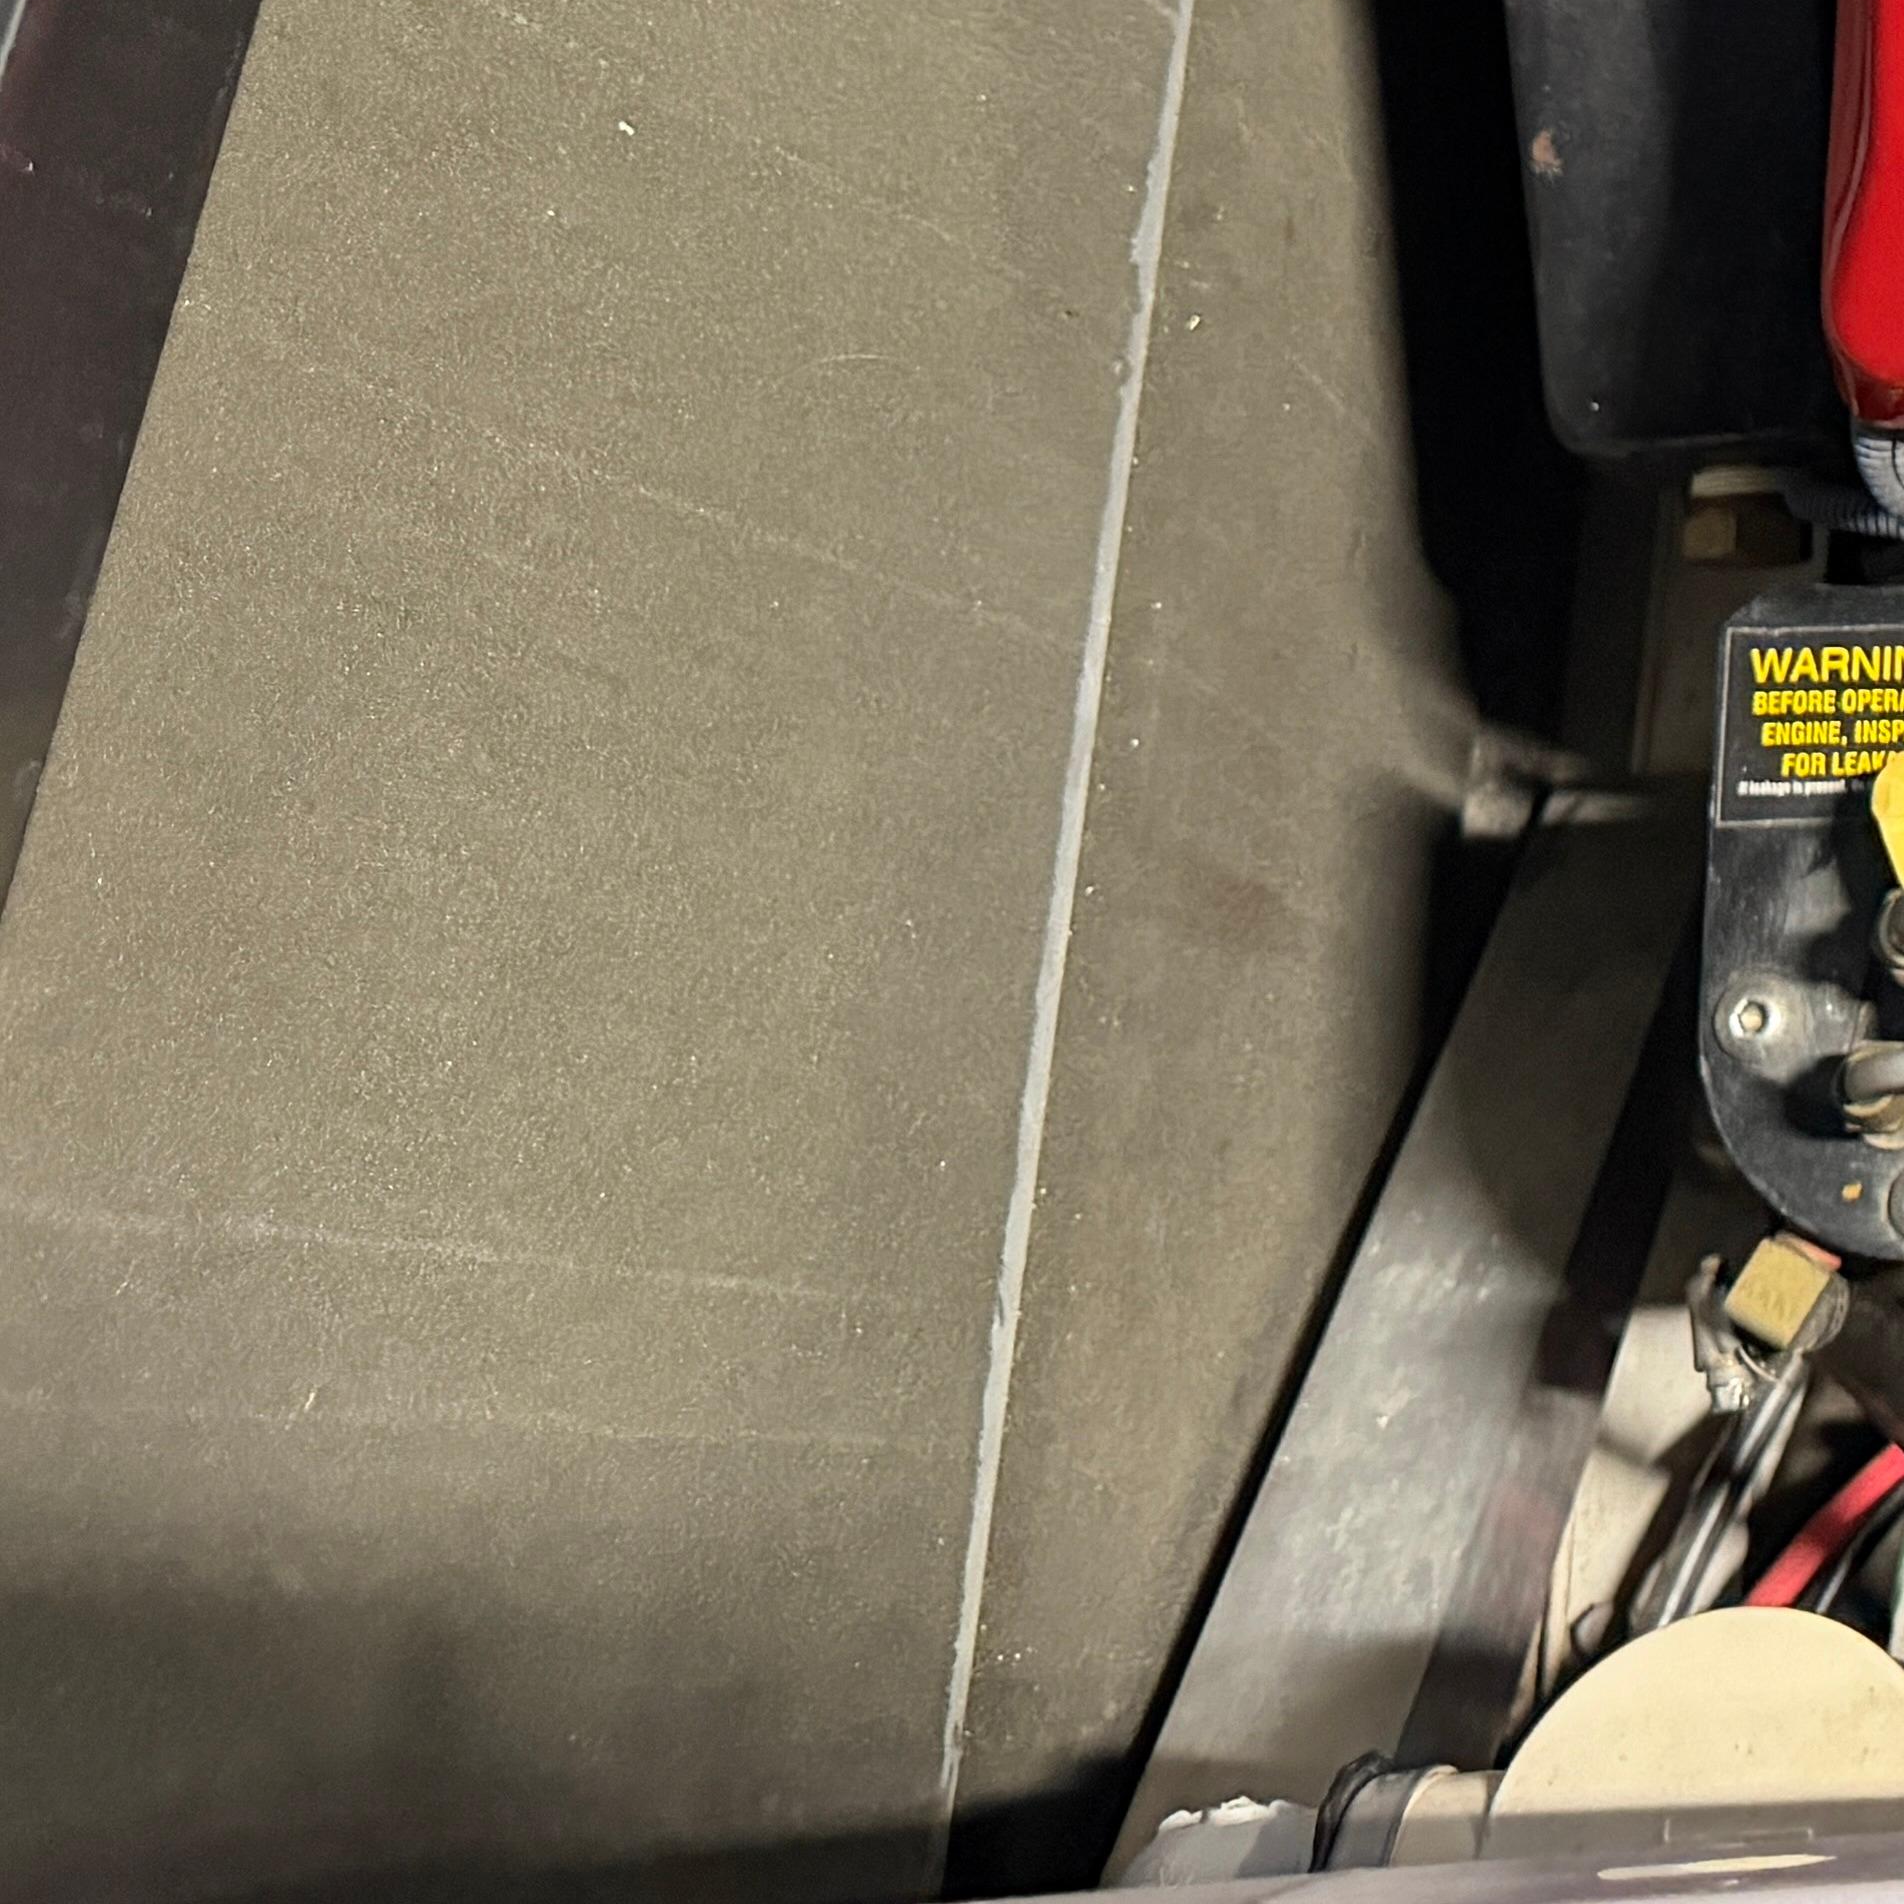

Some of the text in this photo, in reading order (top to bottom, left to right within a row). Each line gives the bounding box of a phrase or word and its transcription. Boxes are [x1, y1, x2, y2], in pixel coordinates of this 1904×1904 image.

[1753, 690, 1837, 716] BEFORE
[1761, 721, 1848, 747] ENGINE,
[1781, 752, 1826, 778] FOR
